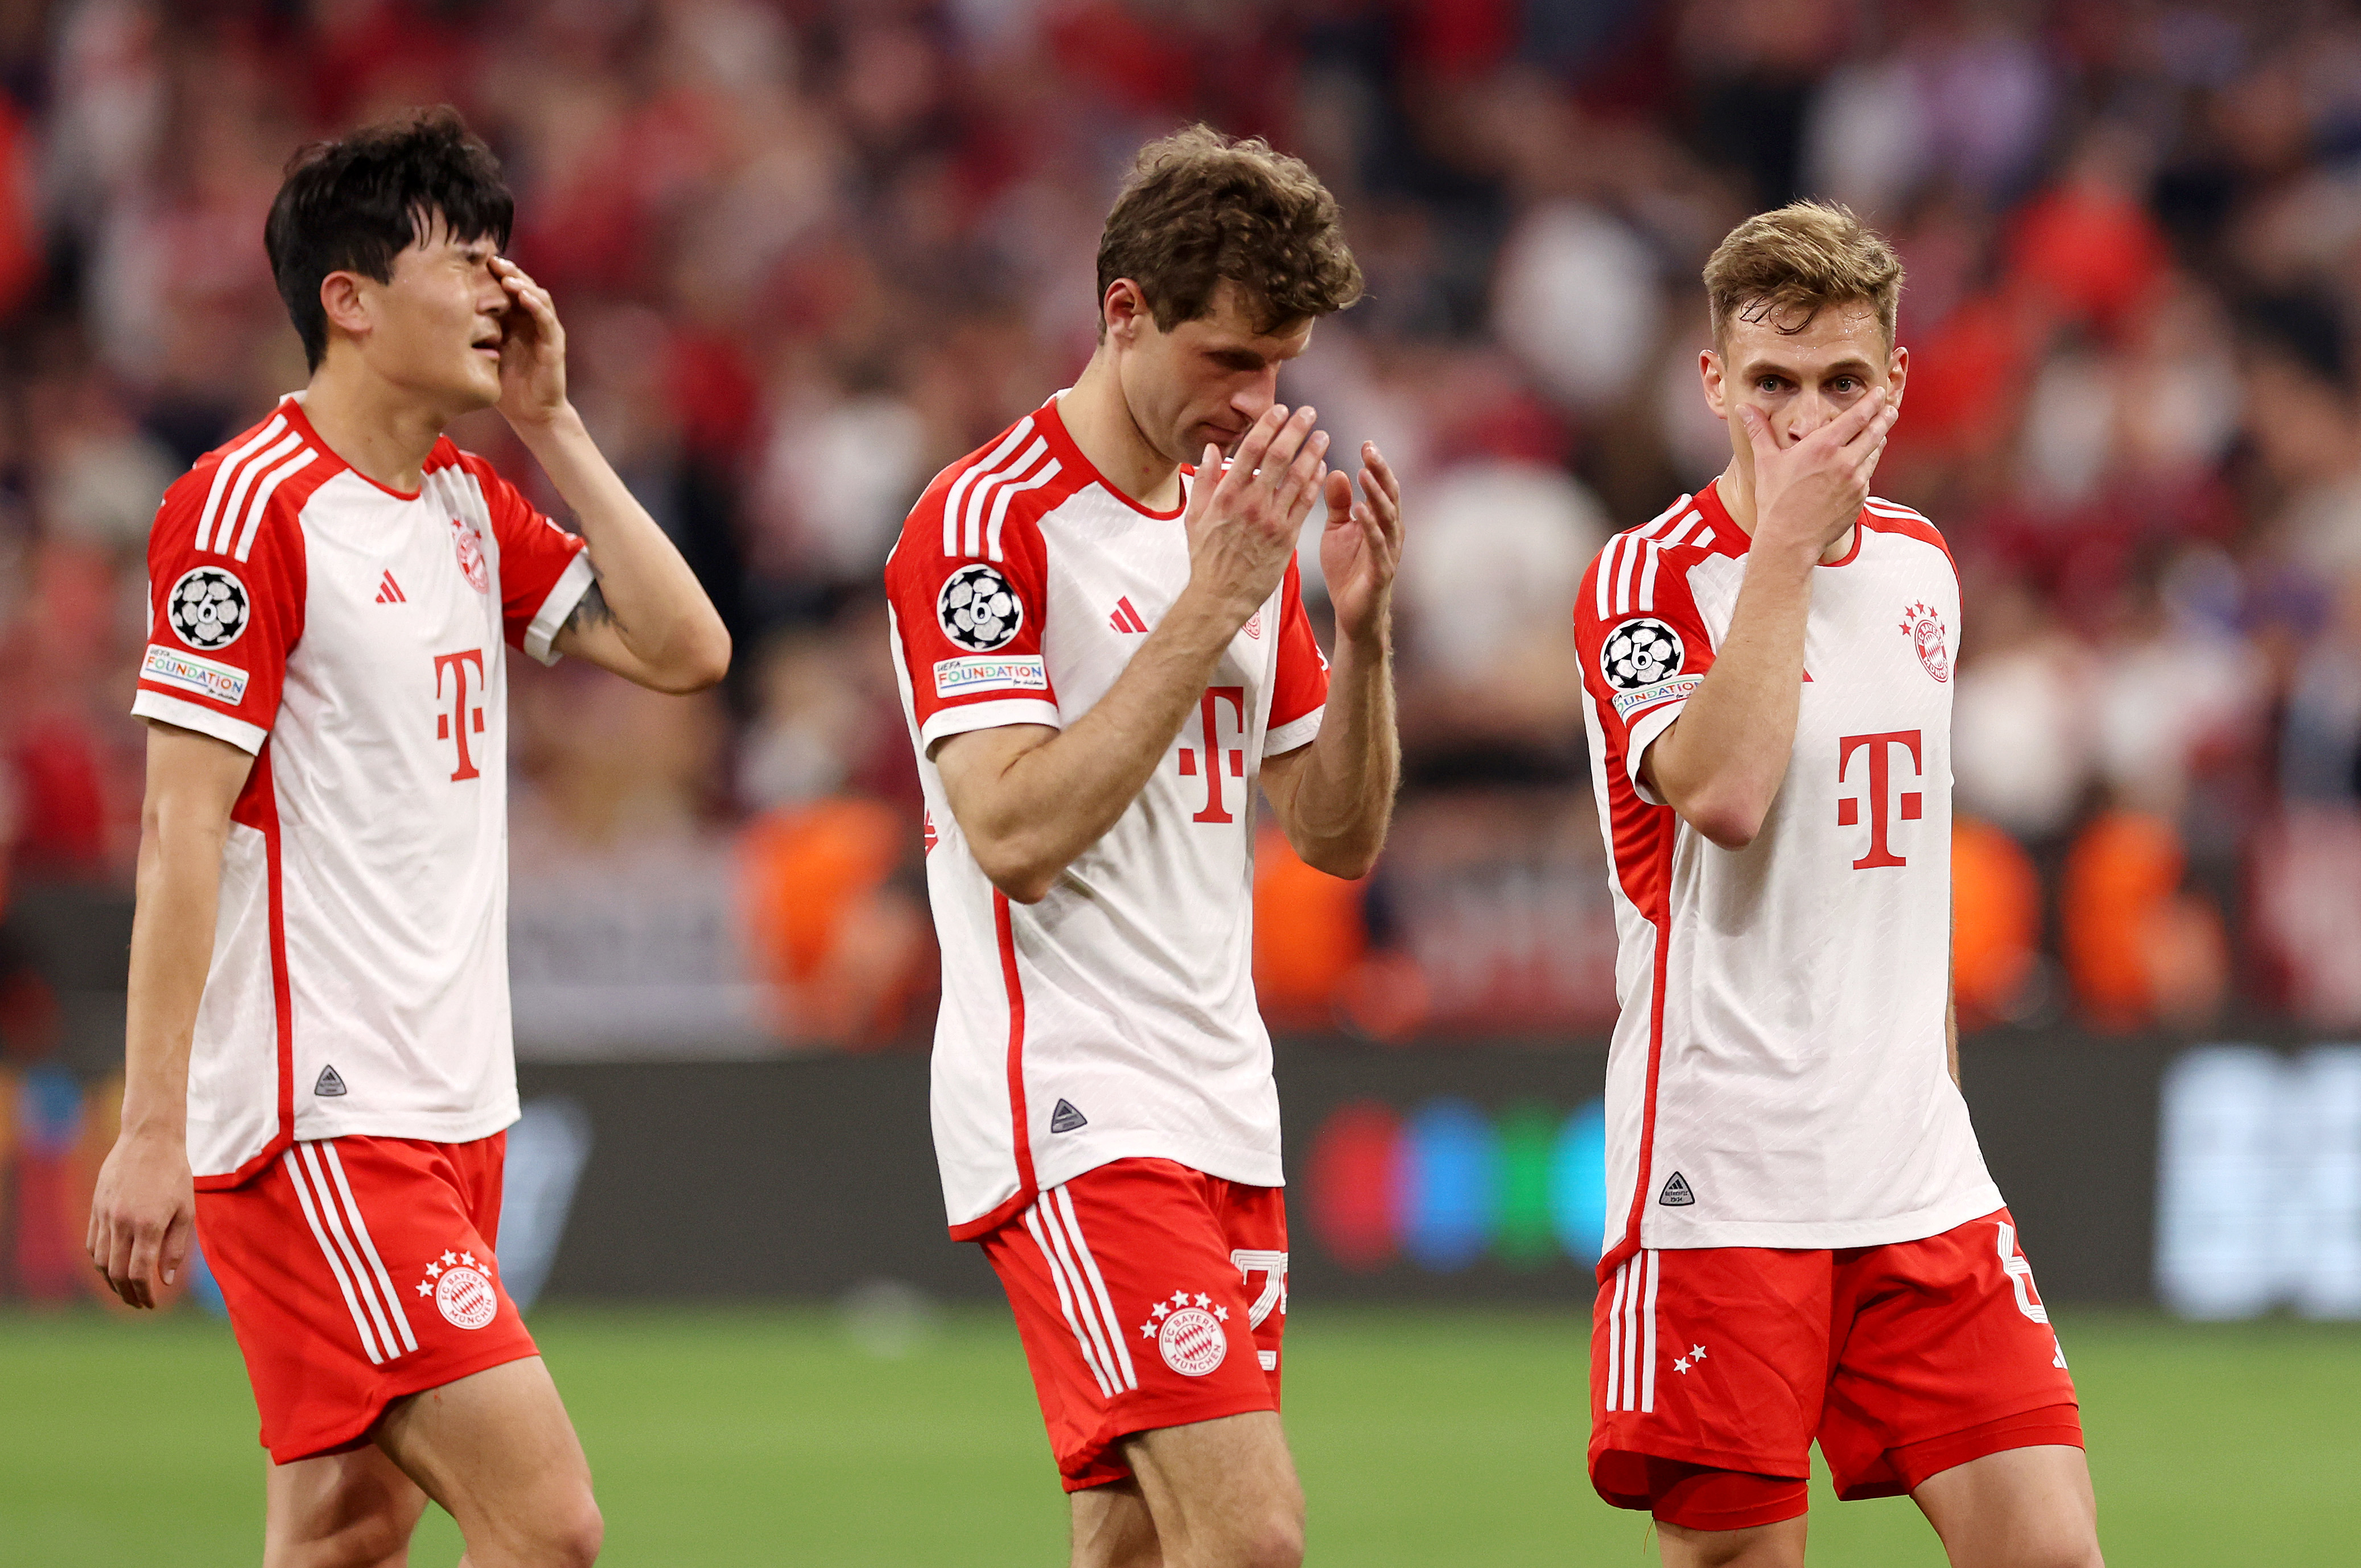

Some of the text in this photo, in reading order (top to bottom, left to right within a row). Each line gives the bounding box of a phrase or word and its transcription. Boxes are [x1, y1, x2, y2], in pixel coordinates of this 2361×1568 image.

[198, 593, 217, 624] 6
[970, 592, 992, 625] 6
[937, 661, 961, 671] UEFA
[1631, 642, 1653, 670] 6
[147, 656, 242, 693] FOUNDATION
[939, 666, 1042, 684] FOUNDATION
[1617, 682, 1698, 715] OUNDATIO
[434, 649, 484, 782] T
[1838, 729, 1921, 870] T
[442, 1273, 484, 1300] FC BAYERN
[1165, 1314, 1217, 1343] FC BAYERN
